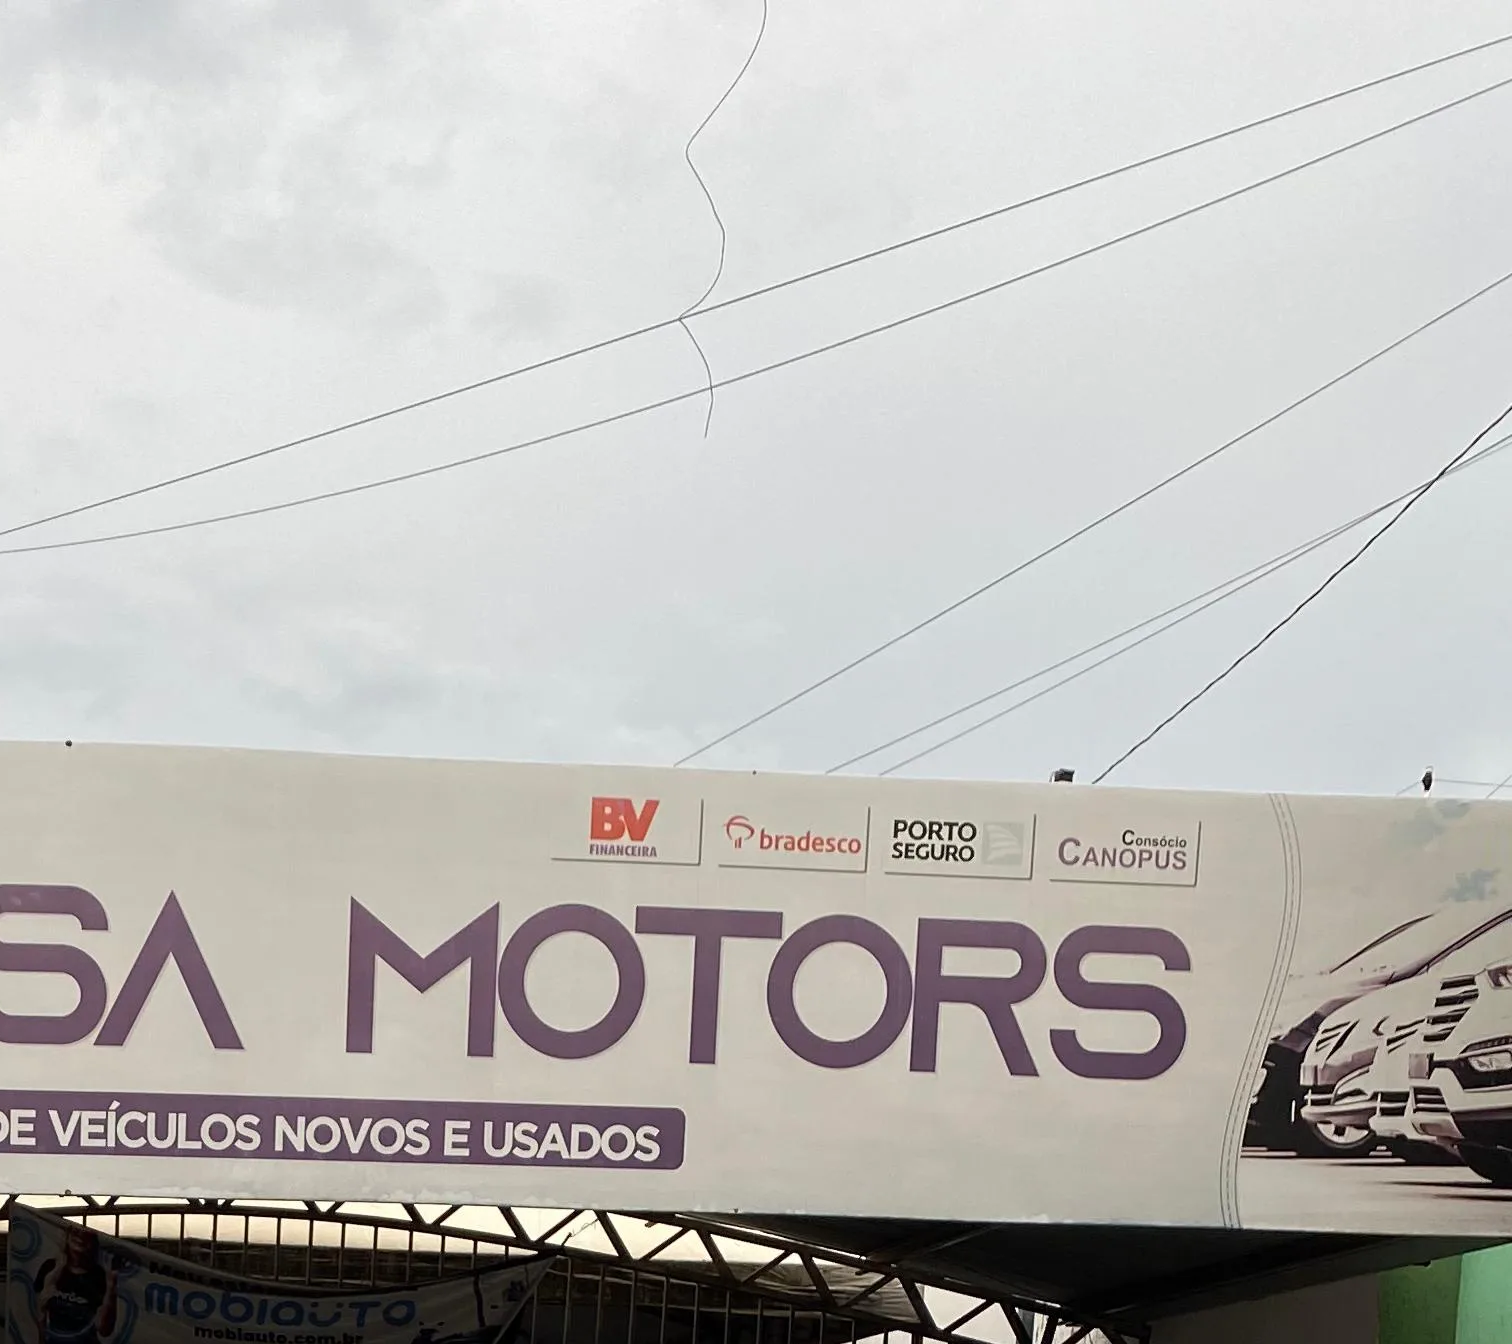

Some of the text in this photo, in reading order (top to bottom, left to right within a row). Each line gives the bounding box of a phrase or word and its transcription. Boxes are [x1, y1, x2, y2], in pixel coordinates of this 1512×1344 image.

[589, 796, 660, 841] BV
[892, 819, 977, 843] PORTO
[589, 843, 658, 858] FINANCEIRA
[759, 830, 862, 855] bradesco
[891, 841, 975, 863] SEGURO
[1057, 836, 1188, 871] CANOPUS
[345, 895, 1194, 1081] MOTORS
[48, 1101, 261, 1151] VEÍCULOS
[274, 1115, 431, 1157] NOVOS
[442, 1119, 471, 1157] E
[483, 1120, 662, 1163] USADOS
